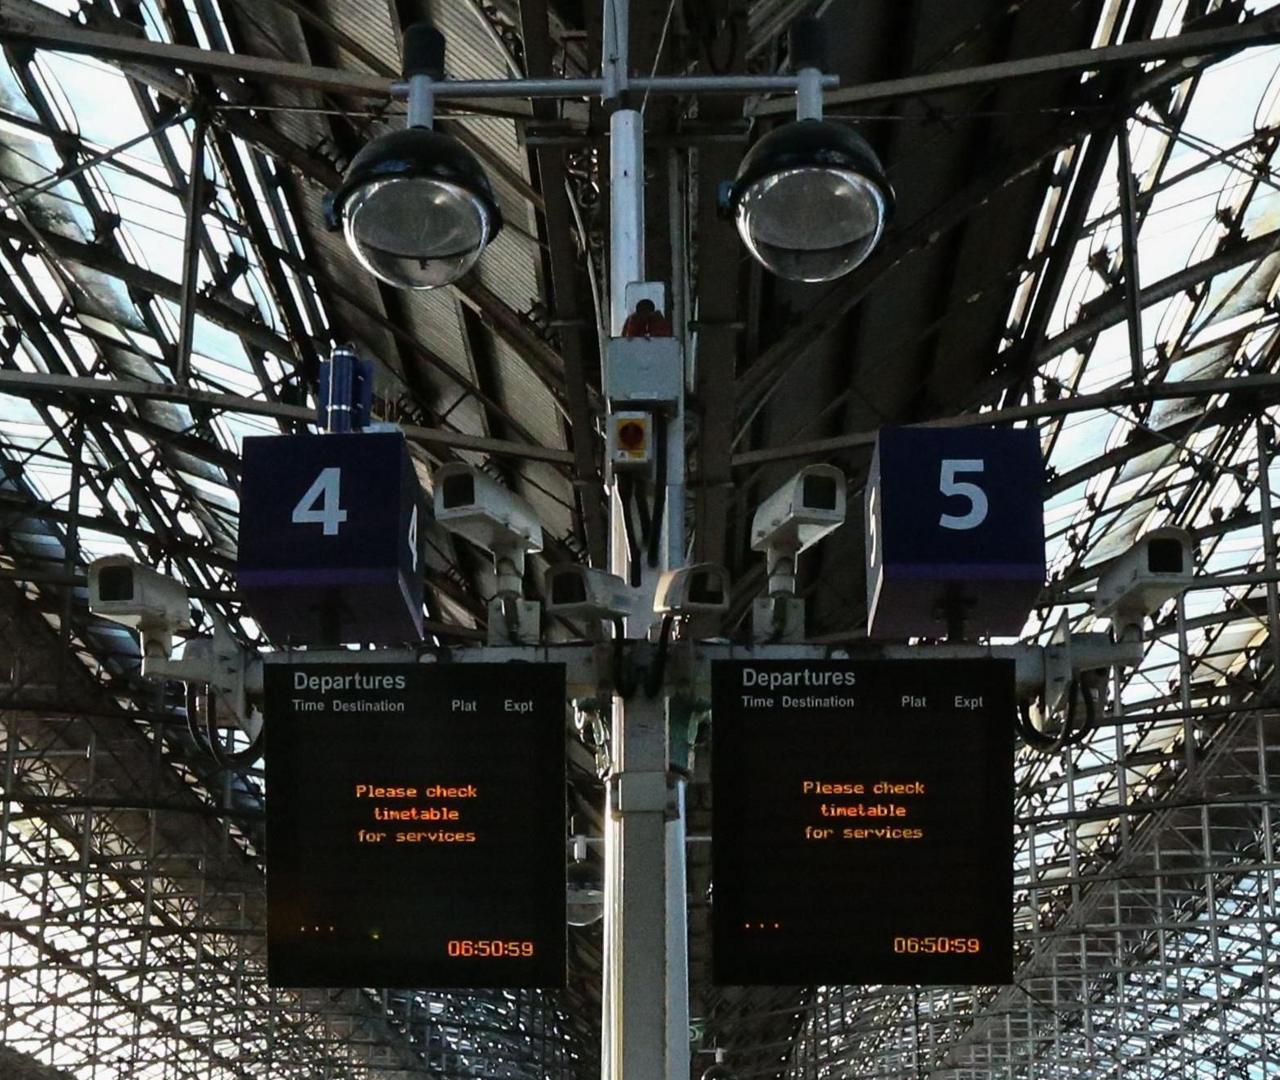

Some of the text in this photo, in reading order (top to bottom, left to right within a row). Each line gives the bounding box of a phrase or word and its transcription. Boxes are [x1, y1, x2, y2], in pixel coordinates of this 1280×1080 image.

[292, 467, 348, 536] 4
[939, 459, 989, 530] 5
[293, 672, 407, 694] Departures
[741, 668, 857, 690] Departures
[292, 699, 534, 714] Time Destination Plat Expt
[741, 695, 984, 711] Time Destination Plat Expt
[356, 784, 478, 798] Please check
[803, 781, 925, 795] Please check
[374, 807, 460, 821] timetable
[820, 803, 907, 817] timetable
[358, 829, 477, 843] for services
[805, 826, 924, 839] for services
[448, 940, 534, 957] 06:50:59
[894, 937, 980, 954] 06:50:59
